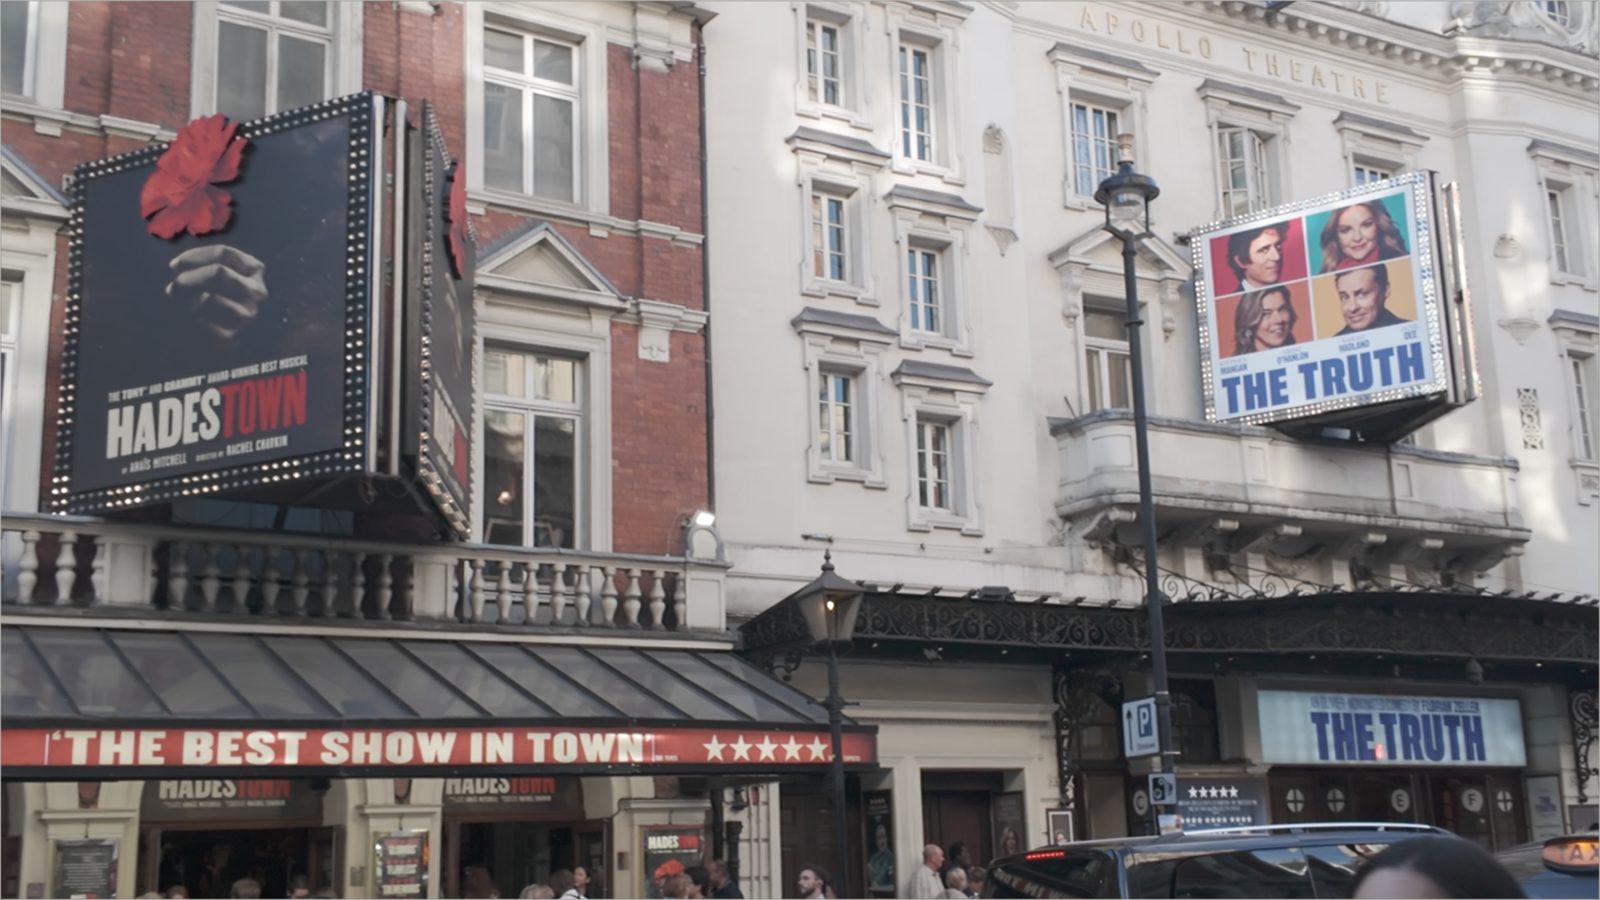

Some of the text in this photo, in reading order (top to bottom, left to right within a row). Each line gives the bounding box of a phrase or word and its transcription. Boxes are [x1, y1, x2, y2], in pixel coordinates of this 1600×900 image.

[1081, 6, 1389, 104] APOLLO THEATRE
[261, 360, 278, 374] BEST
[279, 354, 308, 370] MUSICAL
[1222, 342, 1425, 414] THE TRUTH
[106, 370, 308, 460] HADESTOWN
[153, 453, 187, 469] MITCHELL
[226, 441, 254, 456] RACHEL
[255, 435, 288, 451] CHAVKIN
[1140, 707, 1149, 735] P
[1310, 712, 1486, 761] THE TRUTH
[182, 730, 307, 766] BEST
[320, 731, 456, 765] SHOW
[470, 732, 514, 764] IN
